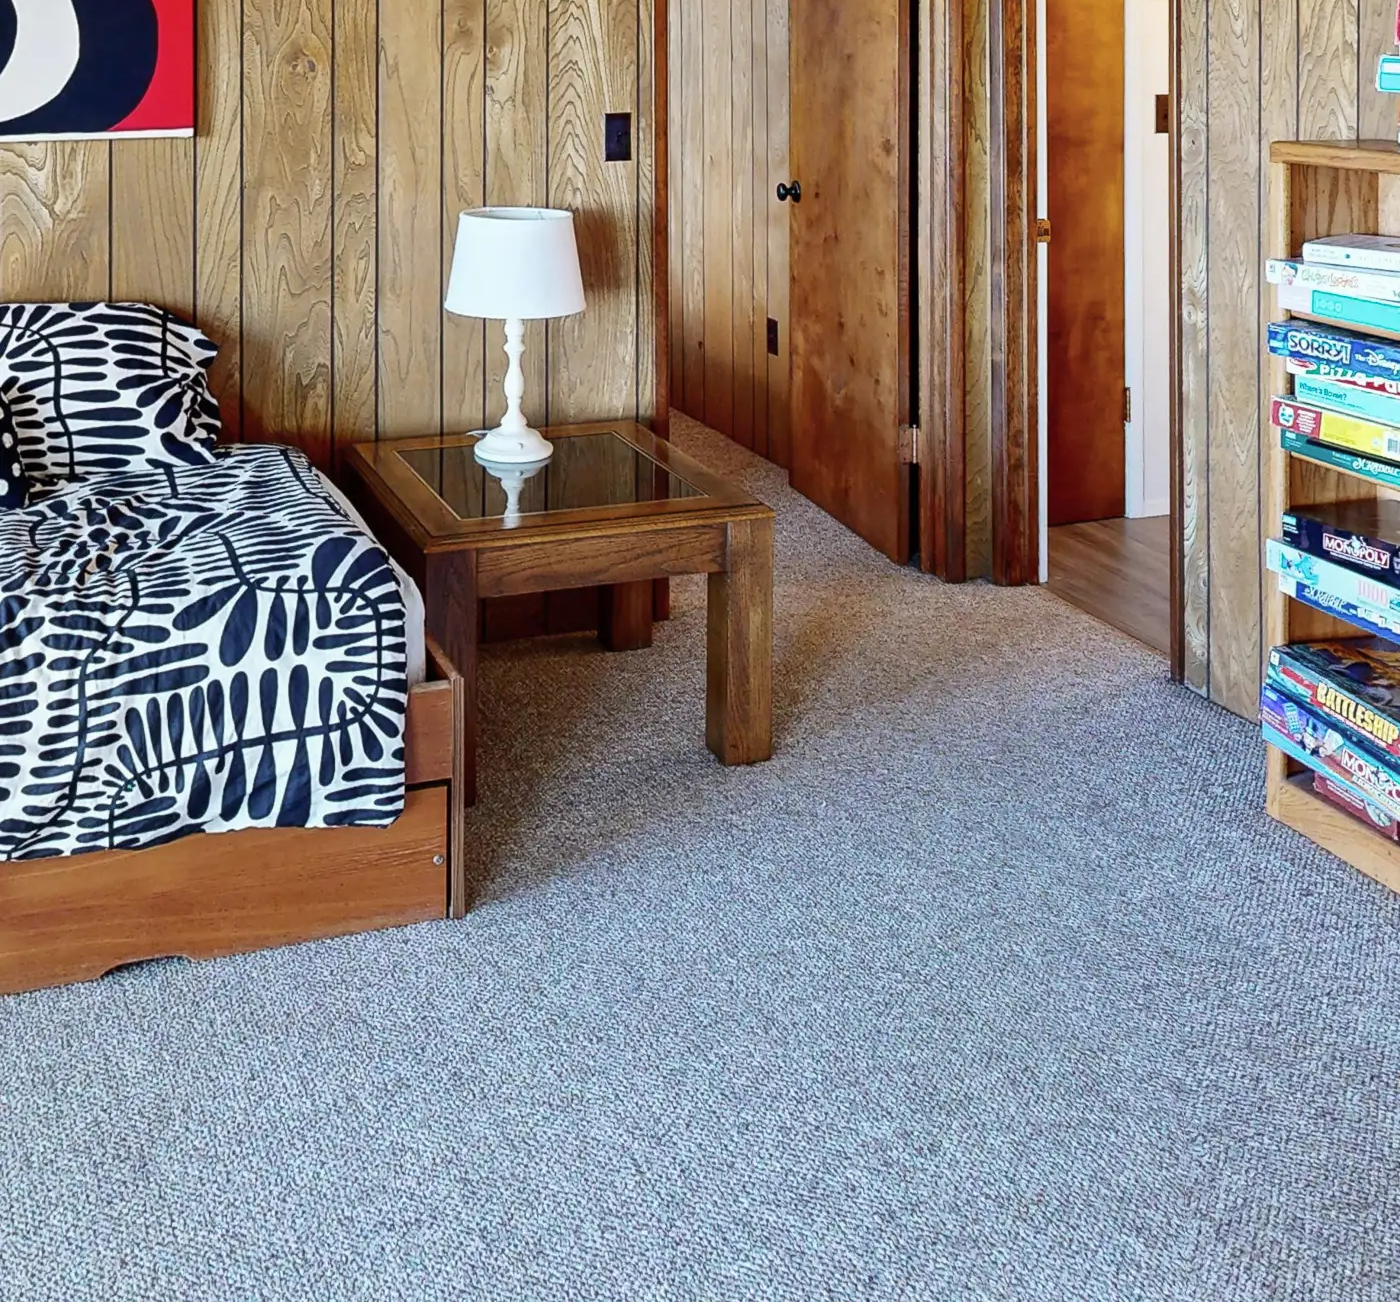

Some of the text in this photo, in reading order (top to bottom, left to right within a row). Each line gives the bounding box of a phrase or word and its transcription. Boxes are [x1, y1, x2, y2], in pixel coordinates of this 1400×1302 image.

[1288, 332, 1351, 363] SORRY!
[1325, 536, 1388, 565] MONOPOLY
[1317, 682, 1399, 744] BATTLESHIP
